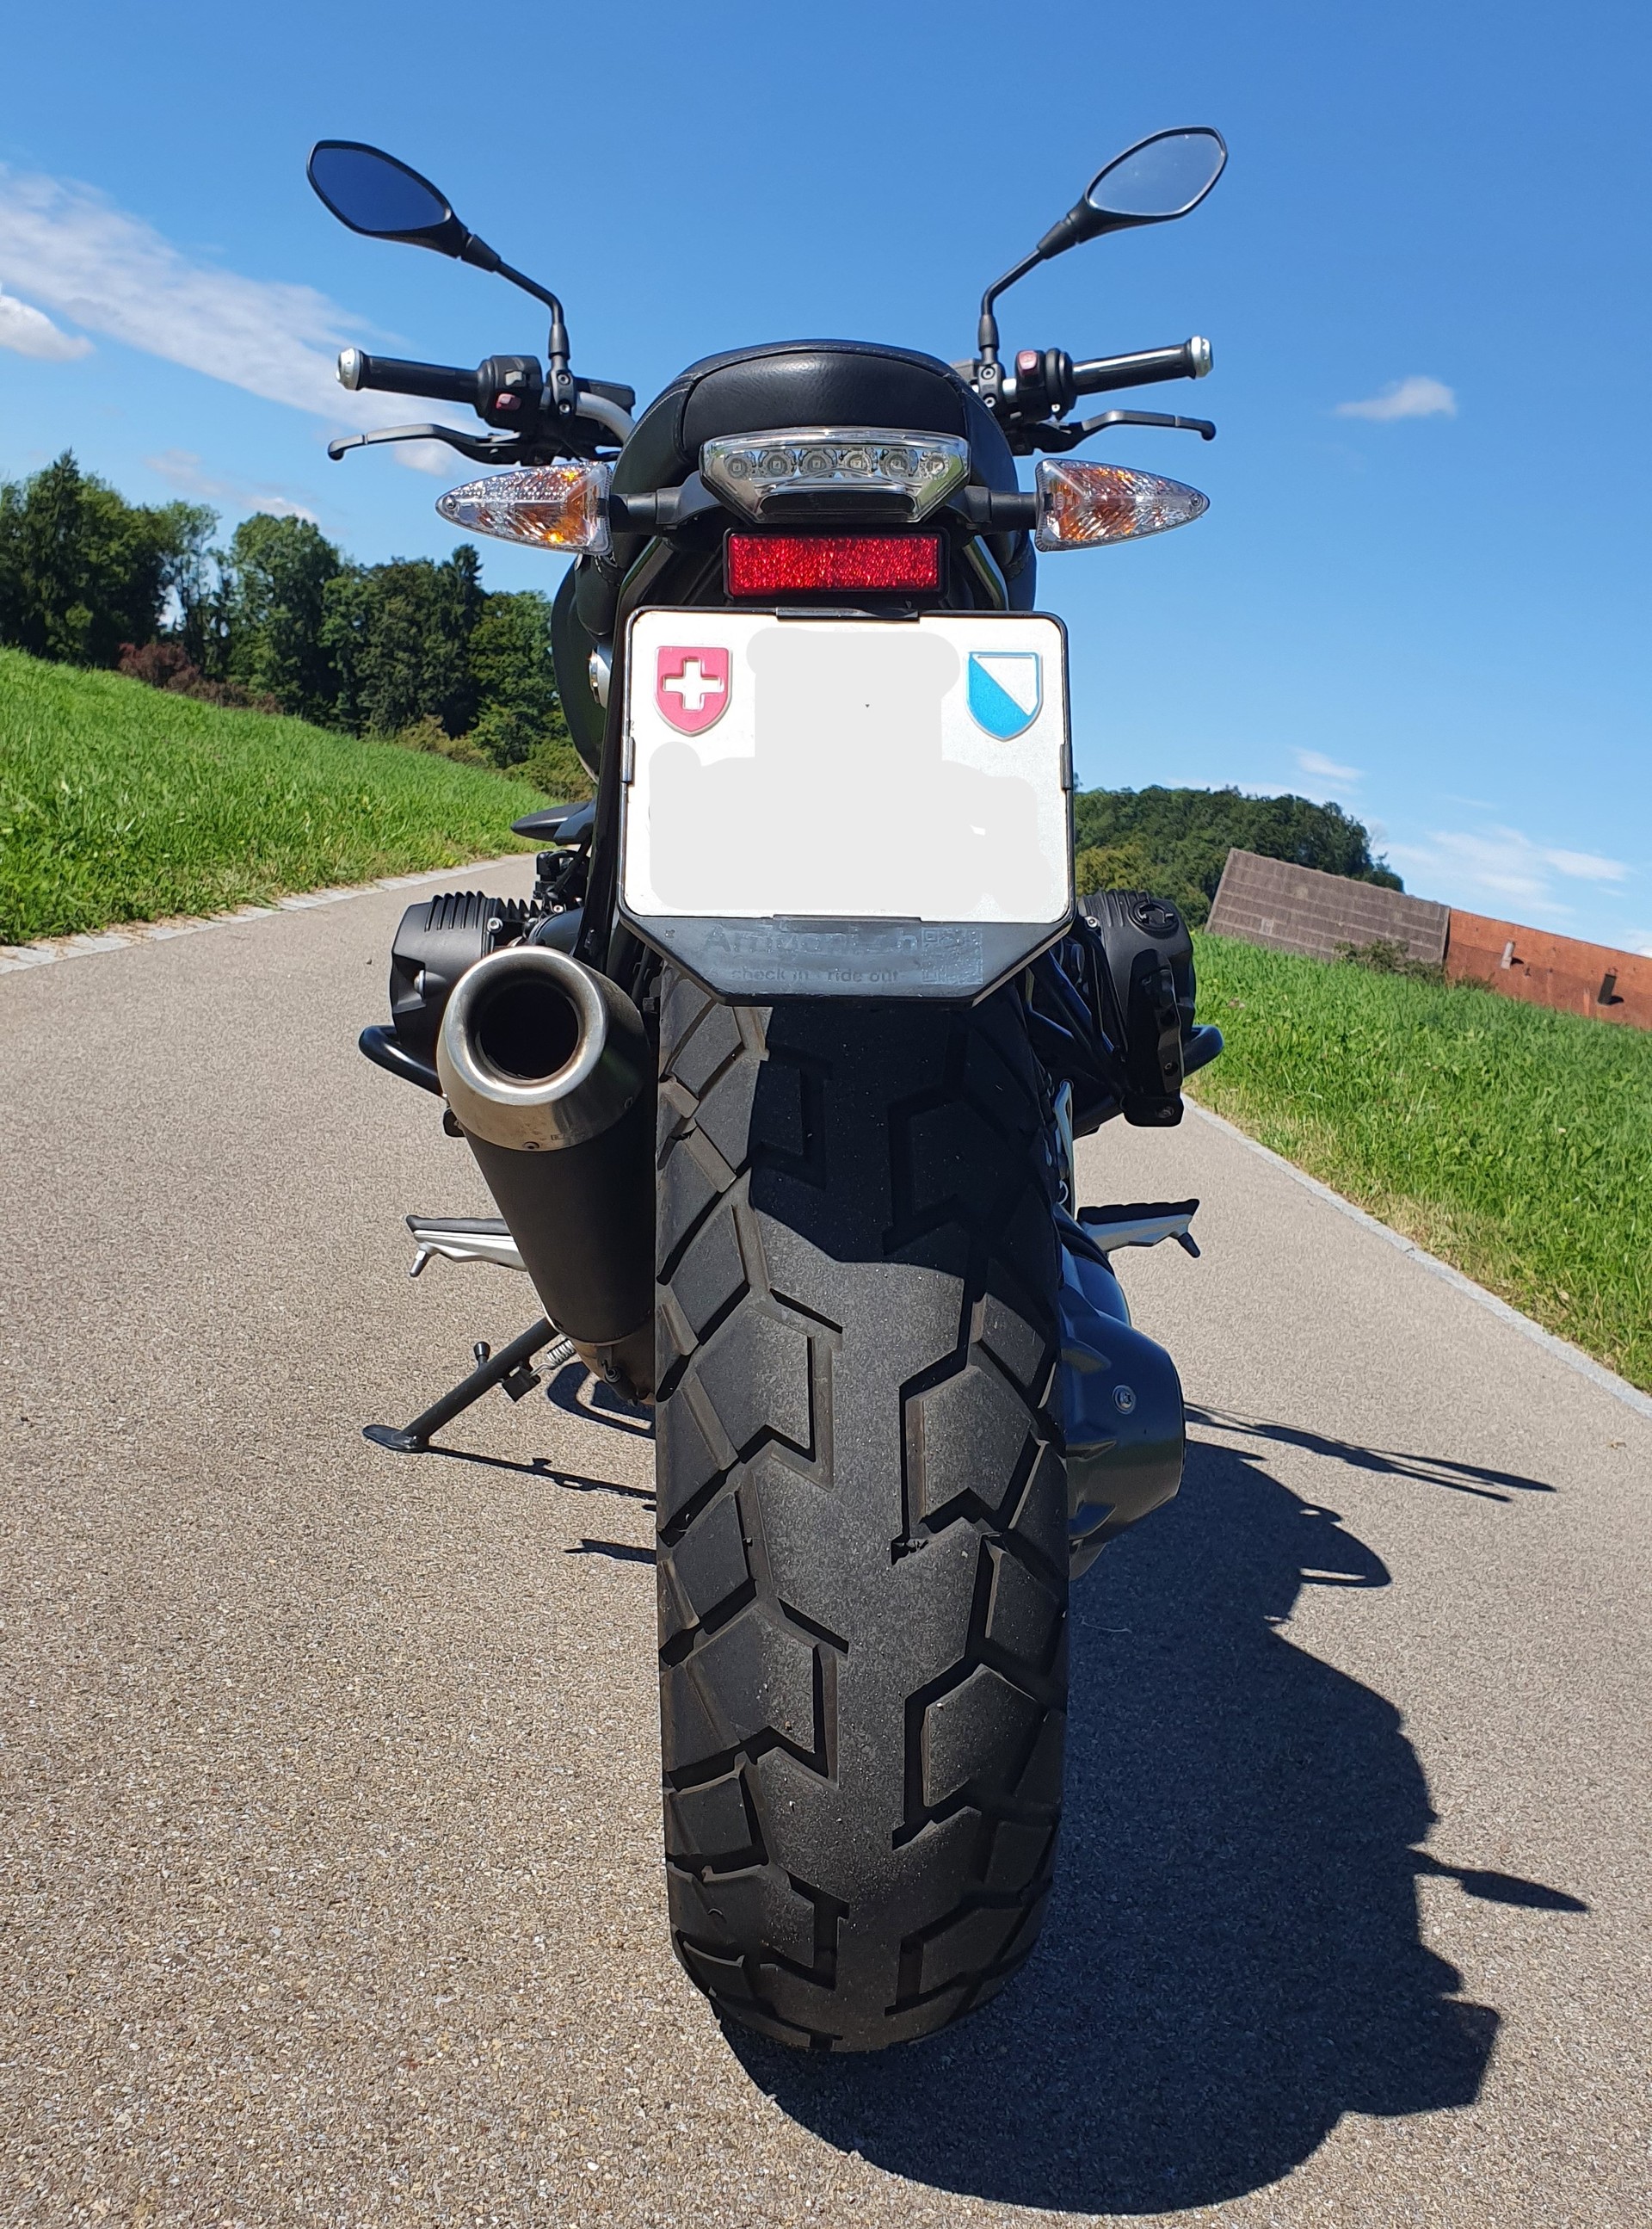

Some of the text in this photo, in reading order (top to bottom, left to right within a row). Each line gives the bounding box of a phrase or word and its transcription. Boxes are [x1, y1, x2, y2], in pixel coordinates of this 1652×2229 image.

[732, 966, 786, 981] check
[827, 967, 861, 983] ride
[869, 968, 899, 983] out
